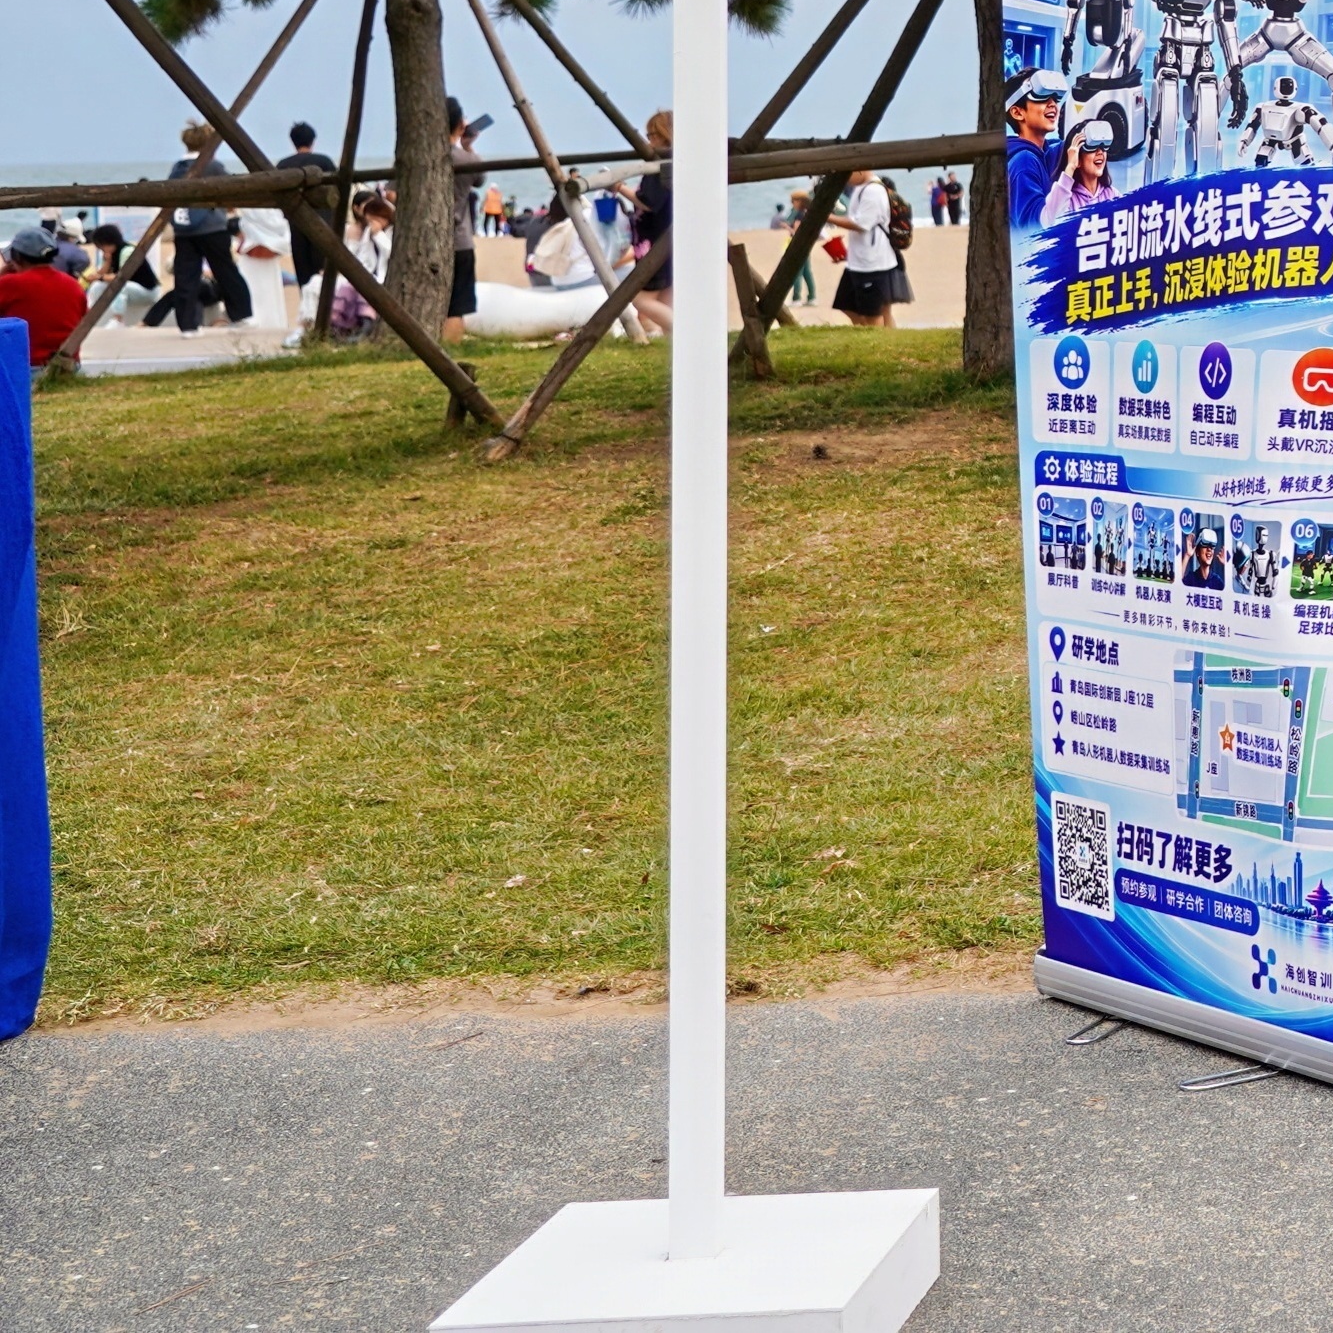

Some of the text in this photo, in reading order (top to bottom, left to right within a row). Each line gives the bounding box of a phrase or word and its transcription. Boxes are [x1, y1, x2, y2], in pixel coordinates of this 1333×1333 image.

[1047, 393, 1098, 414] 深度体验
[1118, 396, 1171, 420] 数据采集特色
[1192, 403, 1237, 426] 编程互动
[1048, 418, 1096, 436] 近距离互动
[1117, 423, 1171, 444] 真实场景真实数据
[1190, 429, 1239, 449] 自己动手编程
[1064, 457, 1119, 486] 体验流程
[1040, 498, 1052, 511] 01
[1093, 502, 1103, 515] 02
[1133, 508, 1144, 520] 03
[1181, 513, 1193, 527] 04
[1232, 519, 1243, 533] 05
[1295, 524, 1315, 538] 06
[1047, 572, 1079, 590] 展厅科普
[1135, 585, 1171, 604] 机器人表演
[1186, 592, 1223, 611] 大模型互动
[1071, 634, 1120, 666] 研学地点
[1069, 679, 1122, 703] 青岛国际创新园
[1236, 730, 1283, 753] 青岛人形机器人
[1072, 739, 1171, 775] 青岛人形机器人数据采集训练场
[1236, 747, 1283, 770] 数据采集训练场
[1116, 820, 1233, 884] 扫码了解更多
[1121, 876, 1253, 927] 预约参观 研学合作 团体咨询
[1285, 962, 1332, 990] 海创智训
